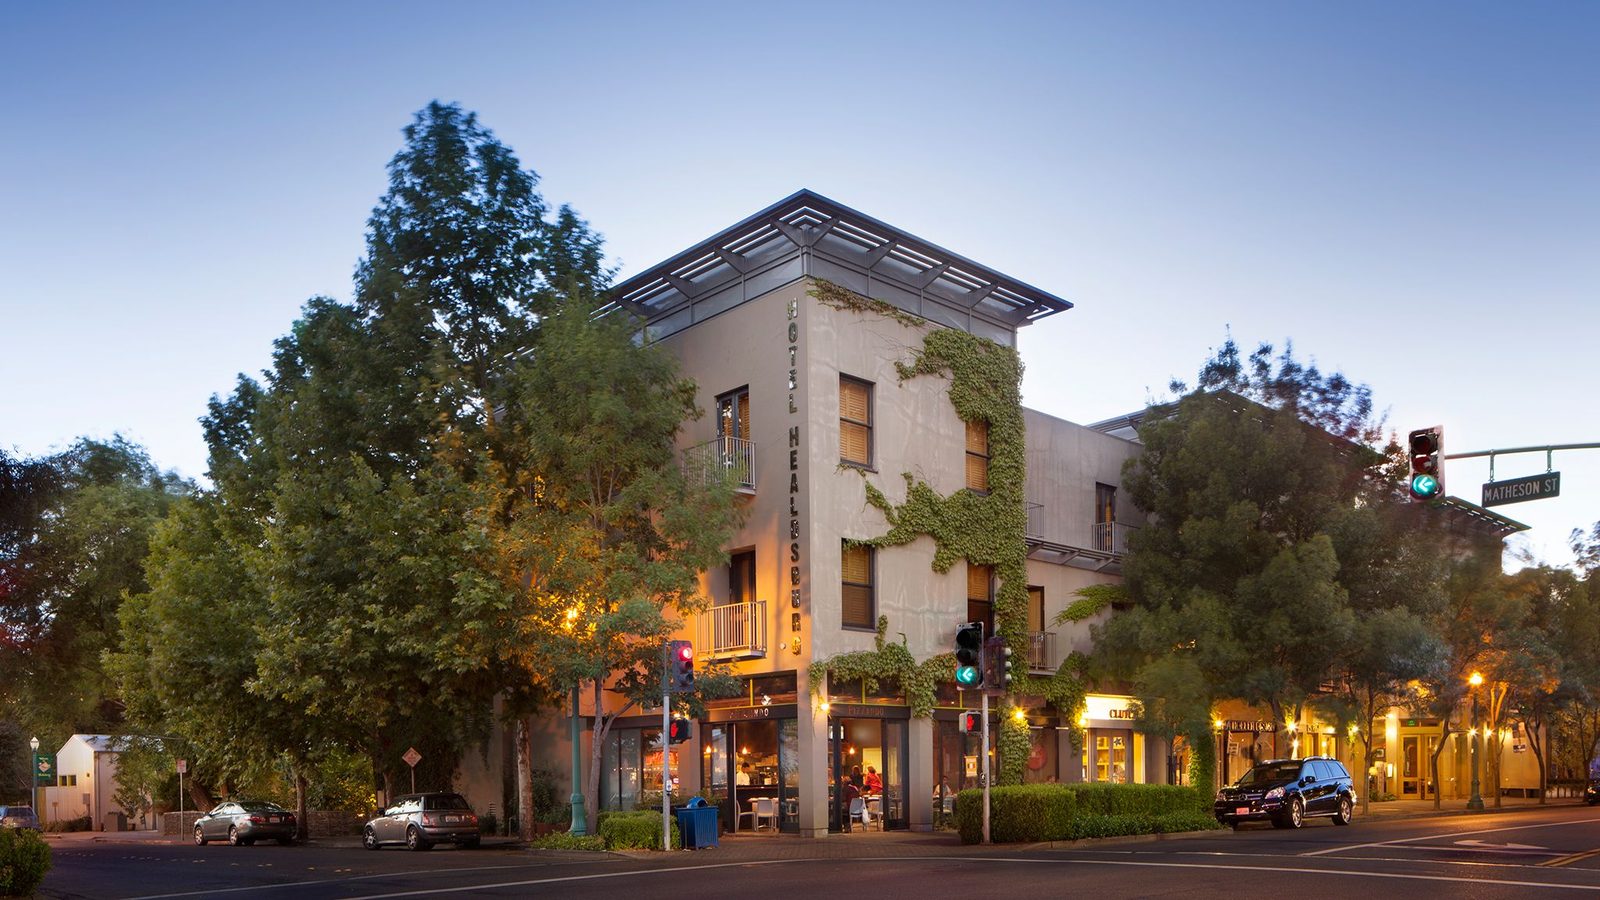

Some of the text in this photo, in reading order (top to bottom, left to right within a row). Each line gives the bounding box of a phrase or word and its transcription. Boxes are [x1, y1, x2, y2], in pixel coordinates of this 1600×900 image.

[787, 297, 798, 414] HOTEL
[1484, 478, 1558, 502] MATHESON ST
[1109, 709, 1134, 719] CLUTC
